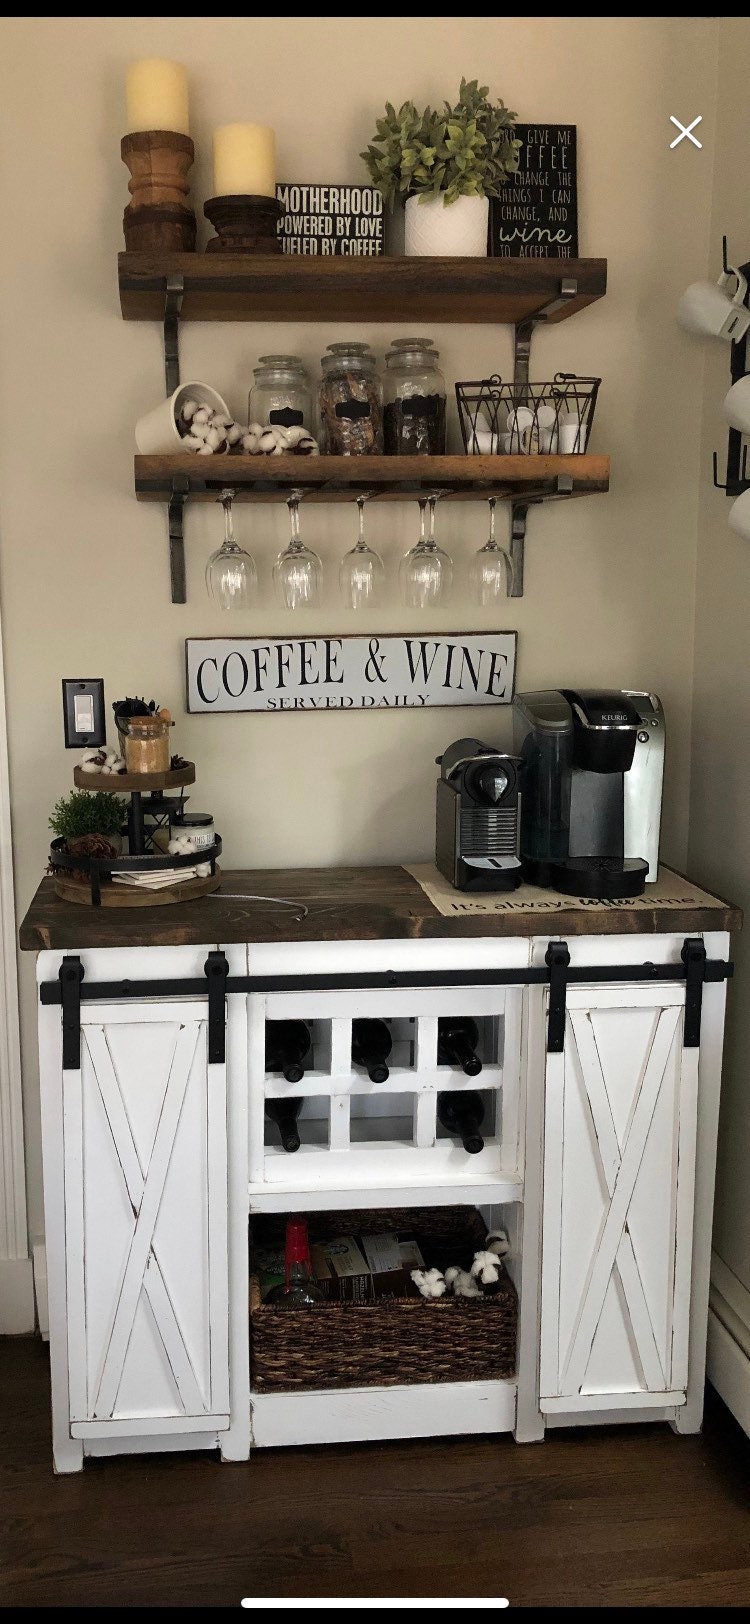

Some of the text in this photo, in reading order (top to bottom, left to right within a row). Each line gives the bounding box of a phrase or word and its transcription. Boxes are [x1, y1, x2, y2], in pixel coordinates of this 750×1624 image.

[527, 129, 549, 145] GIVE
[557, 130, 572, 145] ME
[516, 145, 568, 169] FFEE
[514, 171, 550, 187] CHANGE
[557, 171, 572, 187] THE
[277, 186, 383, 216] MOTHERHOOD
[540, 189, 545, 203] I
[552, 189, 572, 204] CAN
[501, 206, 568, 221] CHANGE, AND
[276, 215, 383, 237] POWERED BY LOVE
[500, 222, 573, 243] wine
[321, 238, 337, 256] BY
[340, 238, 383, 256] COFFEE
[500, 244, 572, 258] TO ACCEPT THE
[196, 638, 508, 704] COFFEE & WINE
[266, 694, 431, 709] SERVED DAILY
[451, 903, 487, 911] It's
[494, 901, 576, 910] always
